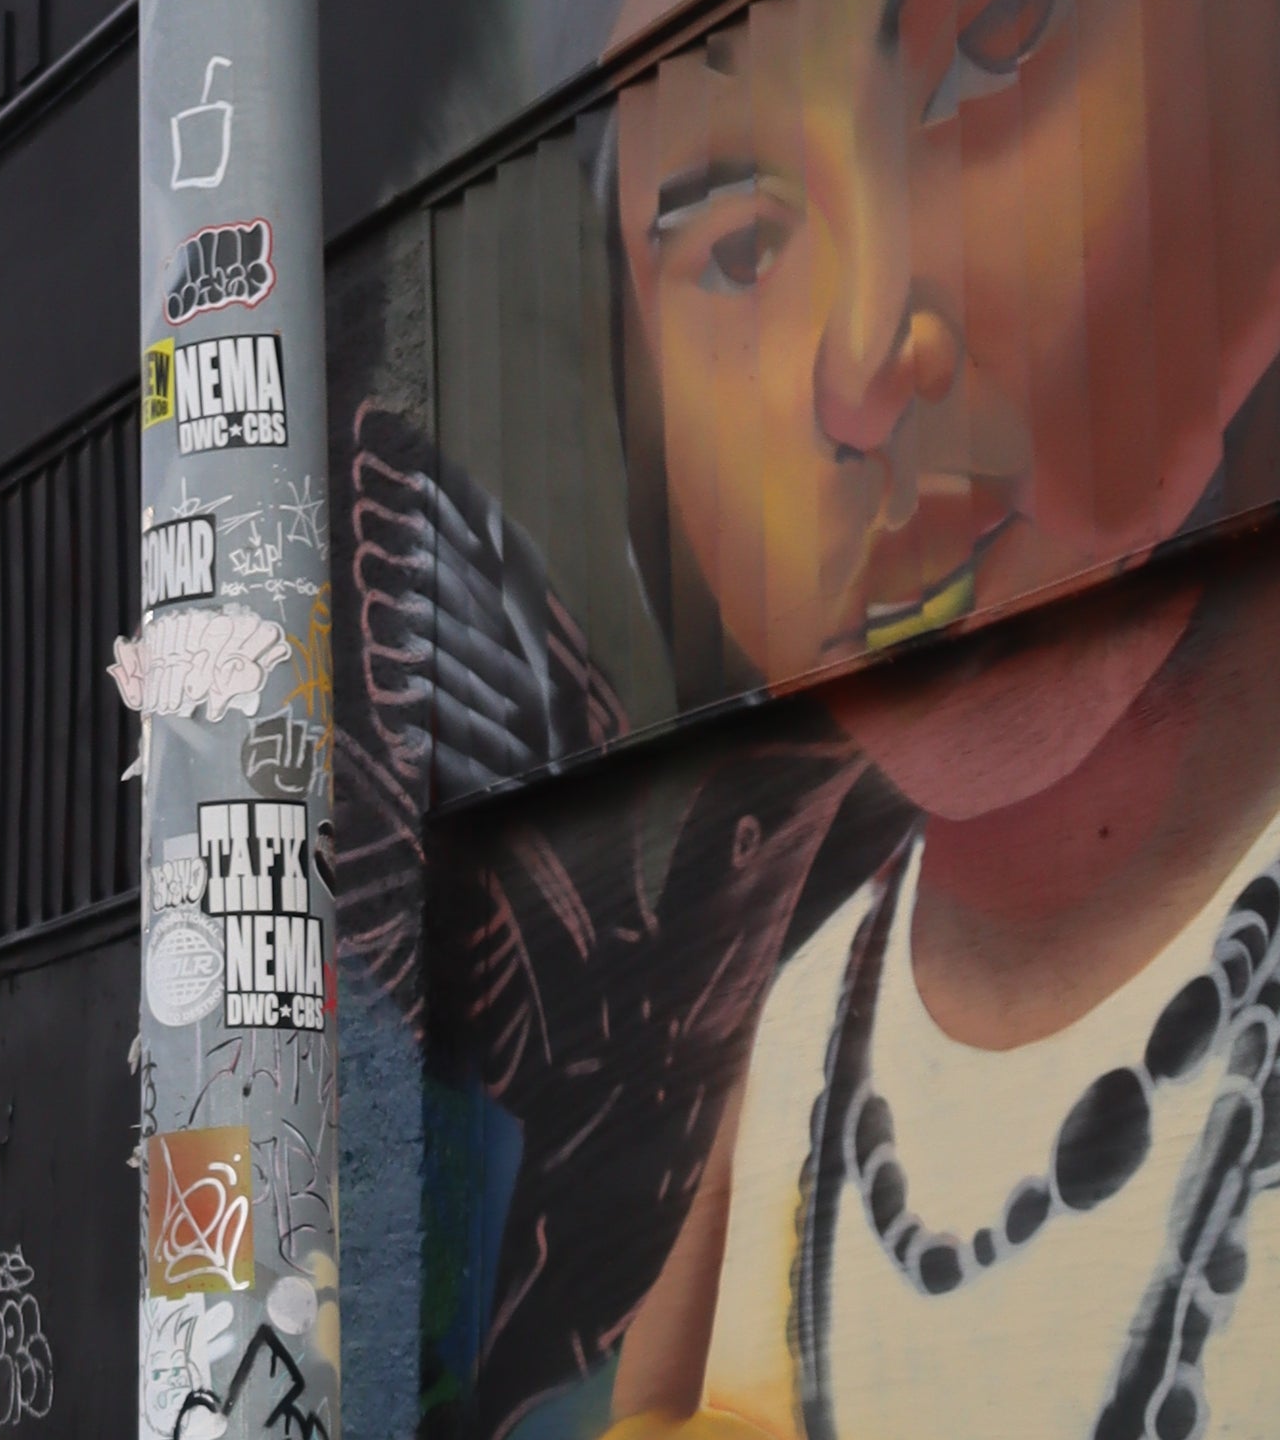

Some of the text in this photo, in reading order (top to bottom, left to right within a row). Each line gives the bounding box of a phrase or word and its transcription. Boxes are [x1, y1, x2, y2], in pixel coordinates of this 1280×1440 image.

[175, 336, 284, 422] NEMA
[179, 412, 286, 454] DWC CBS
[226, 915, 324, 997] NEMA
[226, 993, 324, 1030] DWC CBS
